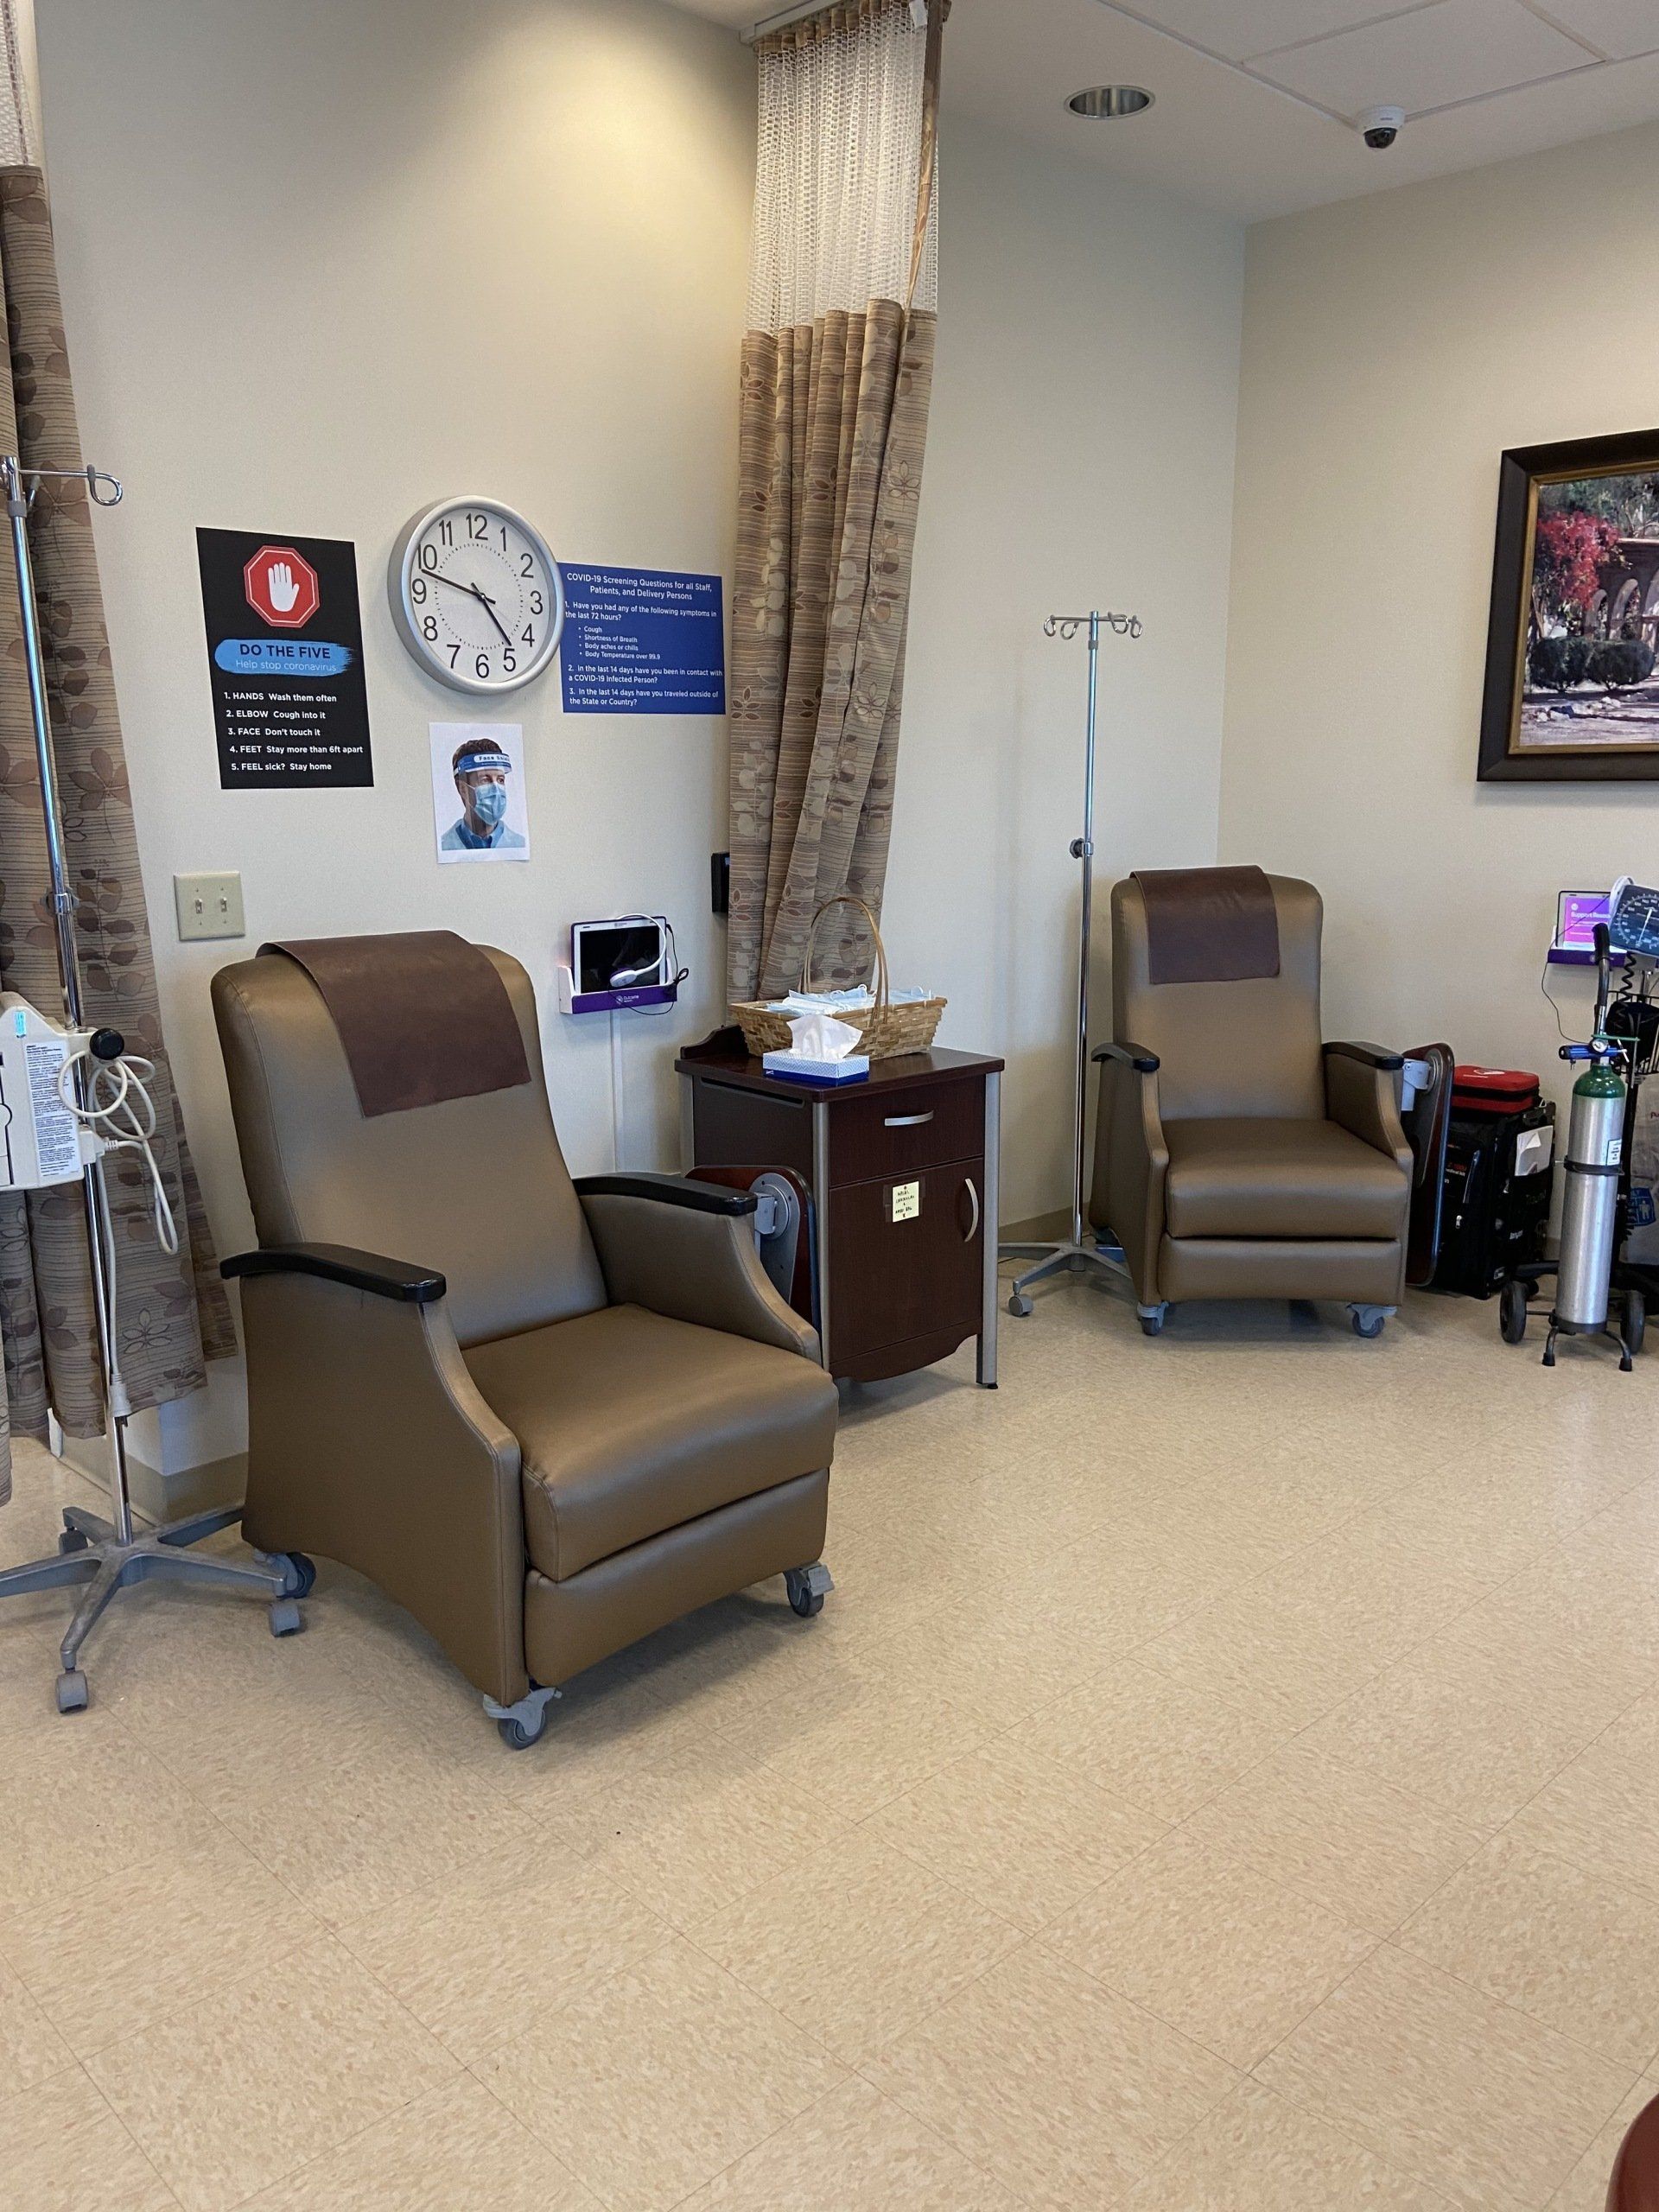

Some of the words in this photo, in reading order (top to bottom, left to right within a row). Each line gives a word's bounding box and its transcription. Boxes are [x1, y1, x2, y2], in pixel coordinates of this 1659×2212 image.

[439, 519, 453, 546] 11
[466, 513, 488, 541] 12
[500, 526, 506, 551] 1
[417, 544, 438, 570] 10
[521, 553, 534, 578] 2
[411, 578, 427, 604] 9
[567, 573, 601, 583] COVID-19
[603, 575, 638, 587] Screening
[639, 579, 673, 588] Questions
[696, 583, 712, 593] Staff,
[531, 590, 543, 615] 3
[590, 586, 621, 596] Patients,
[638, 589, 665, 600] Delivery
[667, 591, 693, 601] Persons
[601, 613, 622, 621] hours?
[651, 607, 678, 616] following
[423, 615, 438, 641] 8
[522, 623, 535, 647] 4
[240, 645, 262, 656] DO
[266, 645, 295, 658] THE
[299, 646, 331, 659] FIVE
[446, 644, 461, 669] 7
[503, 648, 517, 672] 5
[236, 660, 258, 670] Help
[261, 661, 282, 671] stop
[284, 662, 337, 671] coronavirus
[476, 654, 490, 678] 6
[620, 666, 634, 675] days
[315, 694, 337, 702] often
[608, 698, 638, 707] Country?
[620, 689, 635, 697] days
[273, 711, 301, 720] Cough
[266, 746, 285, 754] Stay
[289, 763, 308, 772] Stay
